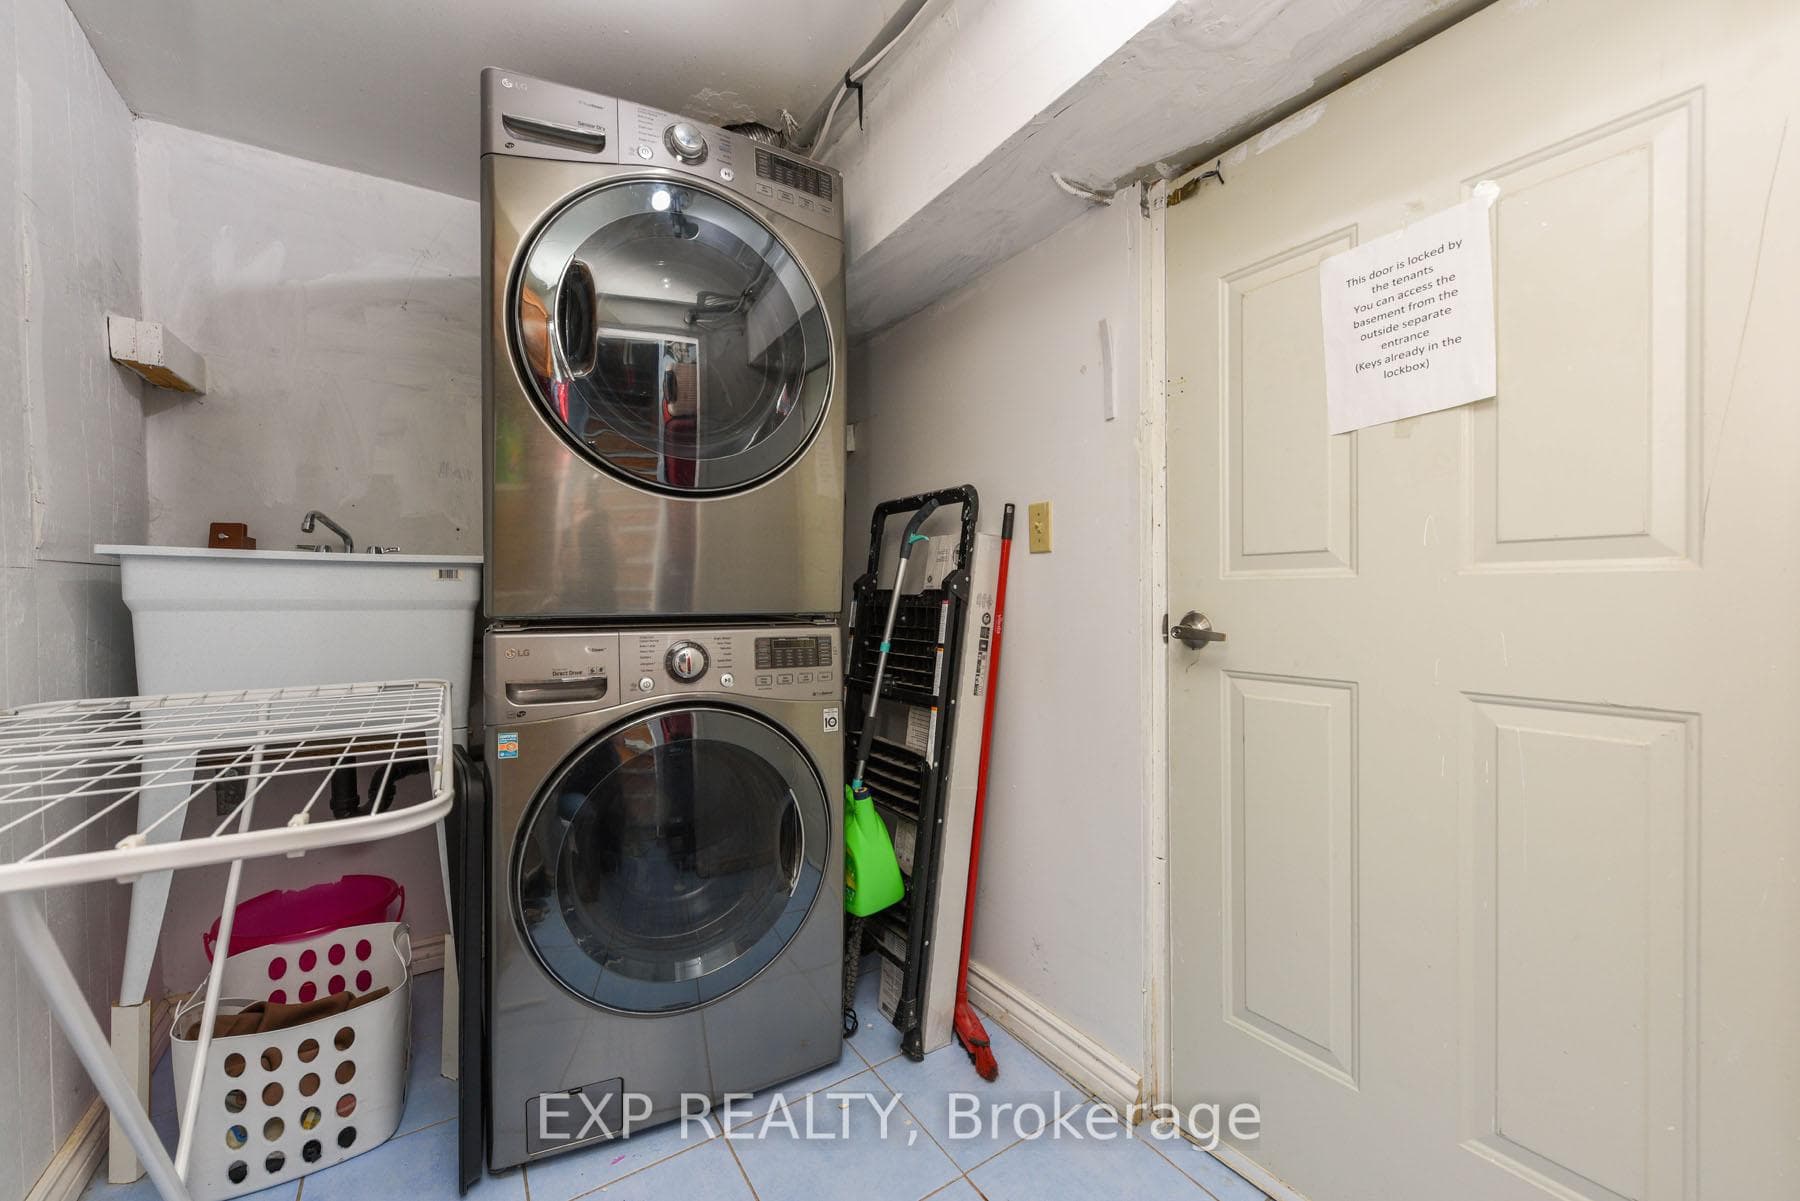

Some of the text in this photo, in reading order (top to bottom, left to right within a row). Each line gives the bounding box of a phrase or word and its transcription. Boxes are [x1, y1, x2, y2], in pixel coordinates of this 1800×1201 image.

[1346, 238, 1462, 288] This door is locked by
[1372, 265, 1434, 294] the tenants
[1353, 288, 1459, 329] basement from the
[1354, 273, 1456, 314] You can access the
[1360, 306, 1452, 342] outside separate
[1381, 329, 1429, 350] entrance
[1355, 335, 1462, 373] (Keys already in the
[1384, 359, 1430, 379] lockbox)
[517, 649, 530, 657] LG
